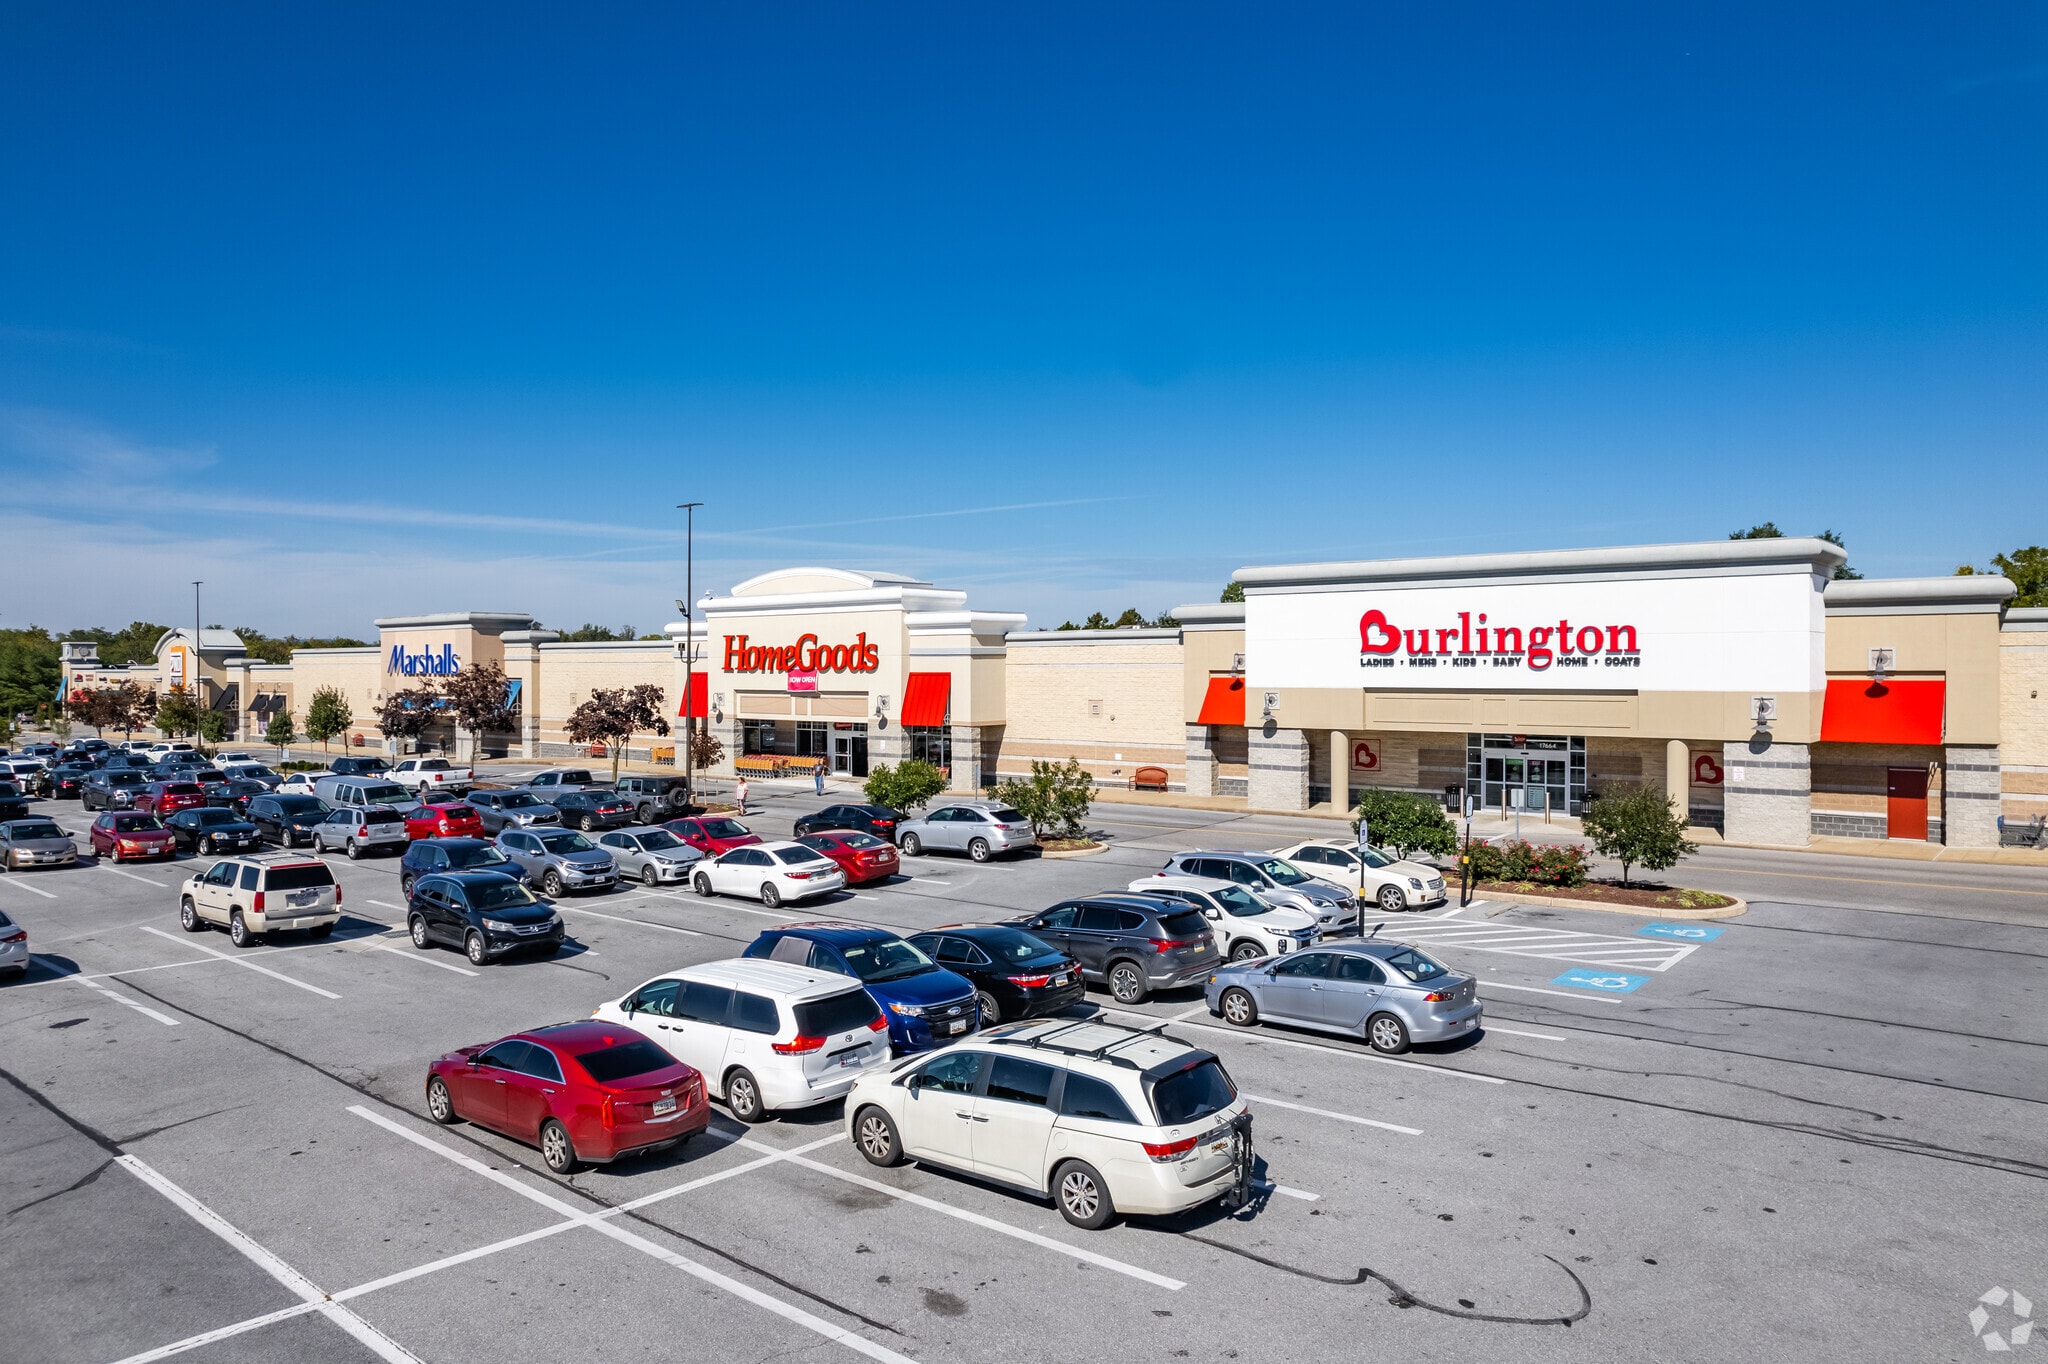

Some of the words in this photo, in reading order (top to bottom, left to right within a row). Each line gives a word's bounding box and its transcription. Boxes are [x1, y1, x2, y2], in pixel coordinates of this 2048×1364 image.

[722, 632, 879, 673] HomeGoods
[1360, 609, 1641, 671] Burlington
[387, 643, 459, 675] Marshalls
[1360, 657, 1395, 668] LADIES
[1408, 657, 1438, 668] MENS
[1452, 657, 1477, 668] KIDS
[1492, 657, 1522, 668] BABY
[1556, 656, 1588, 668] HOME
[1604, 656, 1641, 668] COATS
